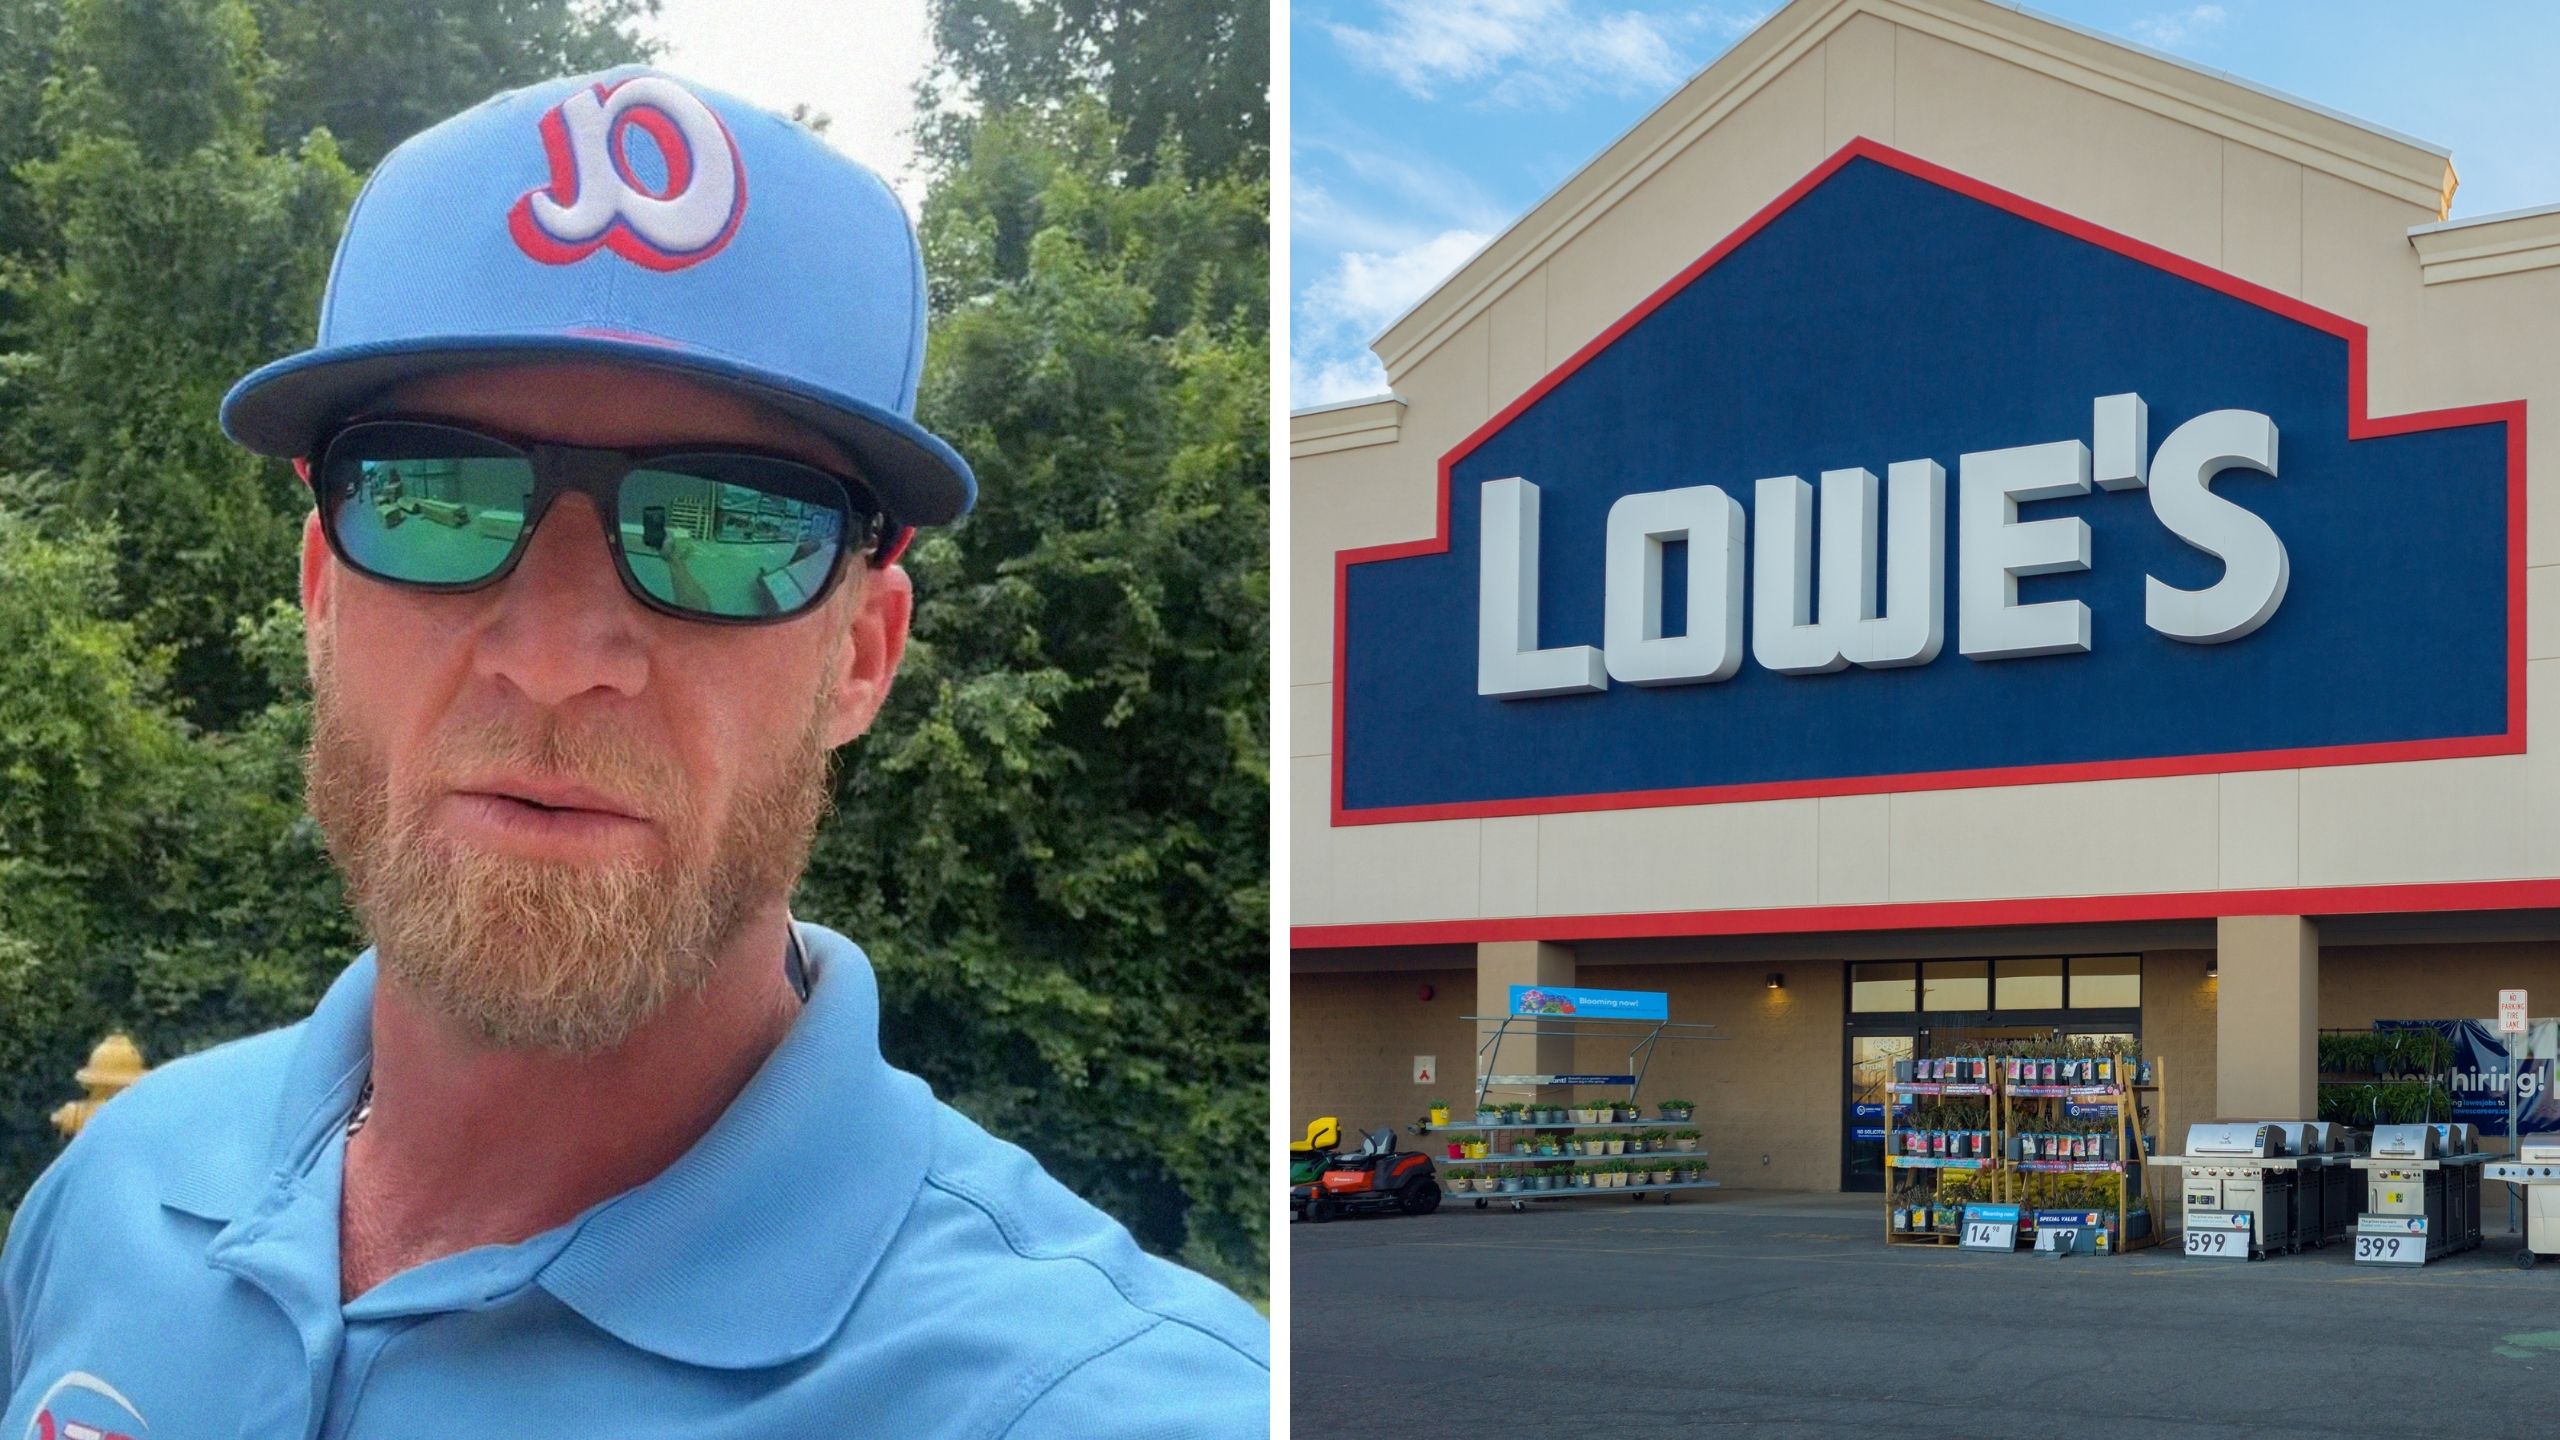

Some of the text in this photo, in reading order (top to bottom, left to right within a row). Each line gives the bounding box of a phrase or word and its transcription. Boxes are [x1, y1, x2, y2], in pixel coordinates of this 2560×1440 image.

[1478, 393, 2289, 700] LOWE'S
[1579, 997, 1639, 1007] Blooming now!
[2451, 1065, 2545, 1098] hiring!
[2463, 1100, 2497, 1108] lowesjobs
[2188, 1233, 2226, 1252] 599
